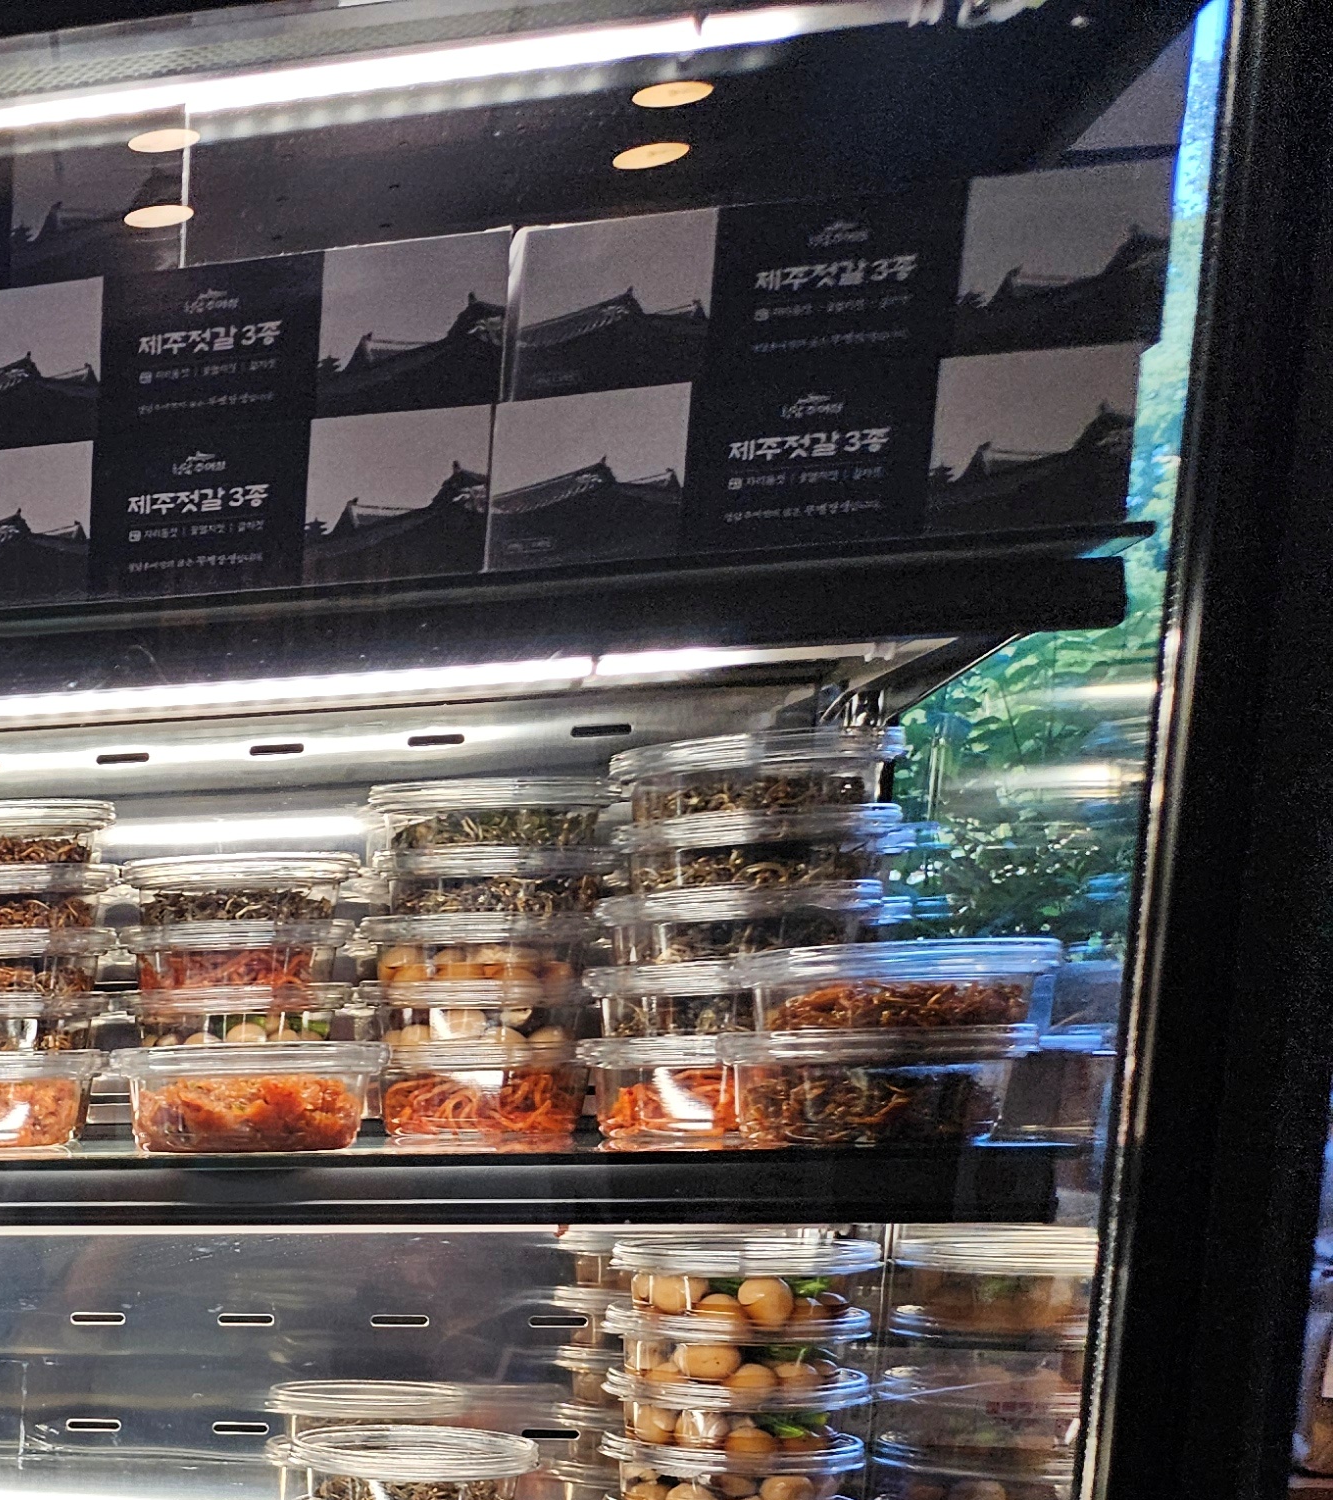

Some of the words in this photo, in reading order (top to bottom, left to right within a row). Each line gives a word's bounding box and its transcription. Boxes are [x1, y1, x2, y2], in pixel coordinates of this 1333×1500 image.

[138, 325, 238, 356] 제주젓갈
[241, 320, 283, 346] 3종
[728, 430, 840, 461] 제주젓갈
[843, 426, 892, 453] 3종
[127, 486, 226, 515] 제주젓갈
[228, 483, 271, 508] 3종
